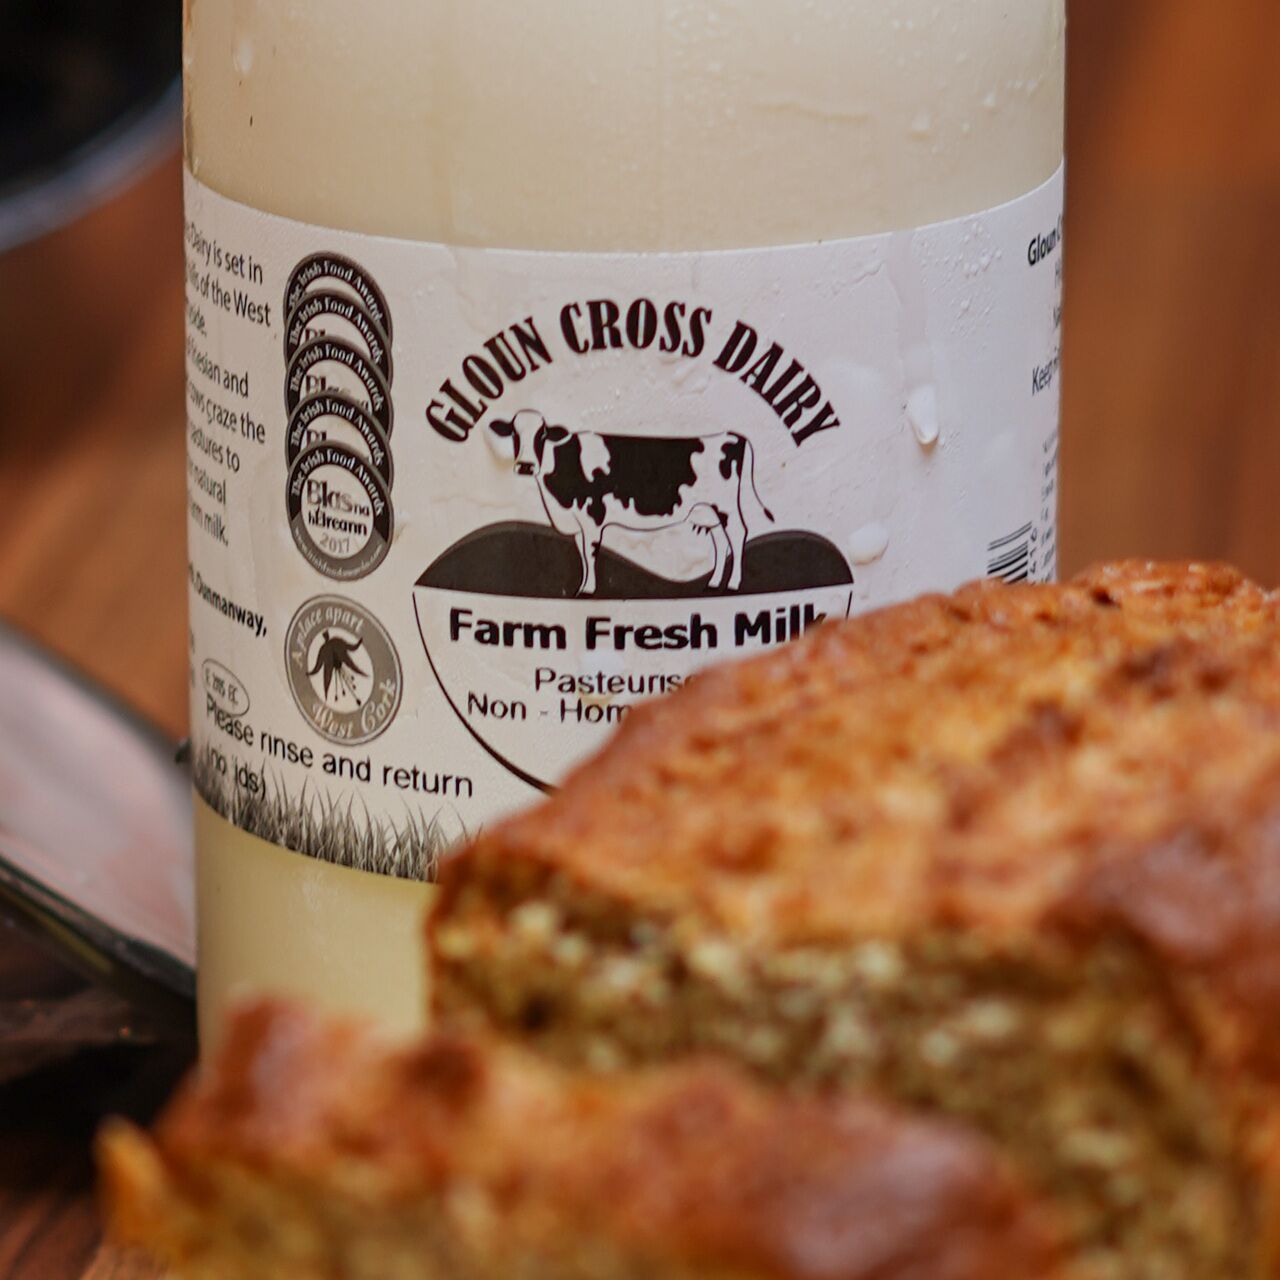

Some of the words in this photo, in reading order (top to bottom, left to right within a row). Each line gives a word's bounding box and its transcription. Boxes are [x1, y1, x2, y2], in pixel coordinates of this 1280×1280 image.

[225, 251, 245, 279] set
[248, 255, 263, 286] in
[324, 260, 353, 281] Food
[354, 277, 383, 321] Award
[211, 278, 231, 312] the
[234, 287, 271, 328] West
[324, 297, 354, 318] Food
[354, 313, 383, 364] Awards
[223, 369, 249, 399] and
[325, 343, 354, 365] Food
[355, 359, 384, 411] Awards
[424, 315, 554, 443] GLOUN
[559, 297, 714, 358] CROSS
[712, 320, 841, 448] DAIRY
[240, 412, 265, 445] the
[326, 398, 355, 420] Food
[355, 415, 384, 465] Awards
[226, 447, 240, 473] to
[301, 450, 324, 474] Irish
[327, 449, 356, 469] Food
[355, 465, 384, 517] Awards
[306, 479, 353, 513] Blas
[354, 504, 370, 517] na
[321, 532, 351, 554] 2017
[325, 606, 365, 632] apart
[449, 607, 567, 651] Farm
[585, 615, 719, 651] Fresh
[312, 702, 353, 738] West
[360, 678, 396, 734] Cork
[468, 691, 527, 721] Non
[207, 690, 254, 746] Please
[260, 731, 314, 768] rinse
[322, 752, 371, 783] and
[383, 764, 473, 798] return
